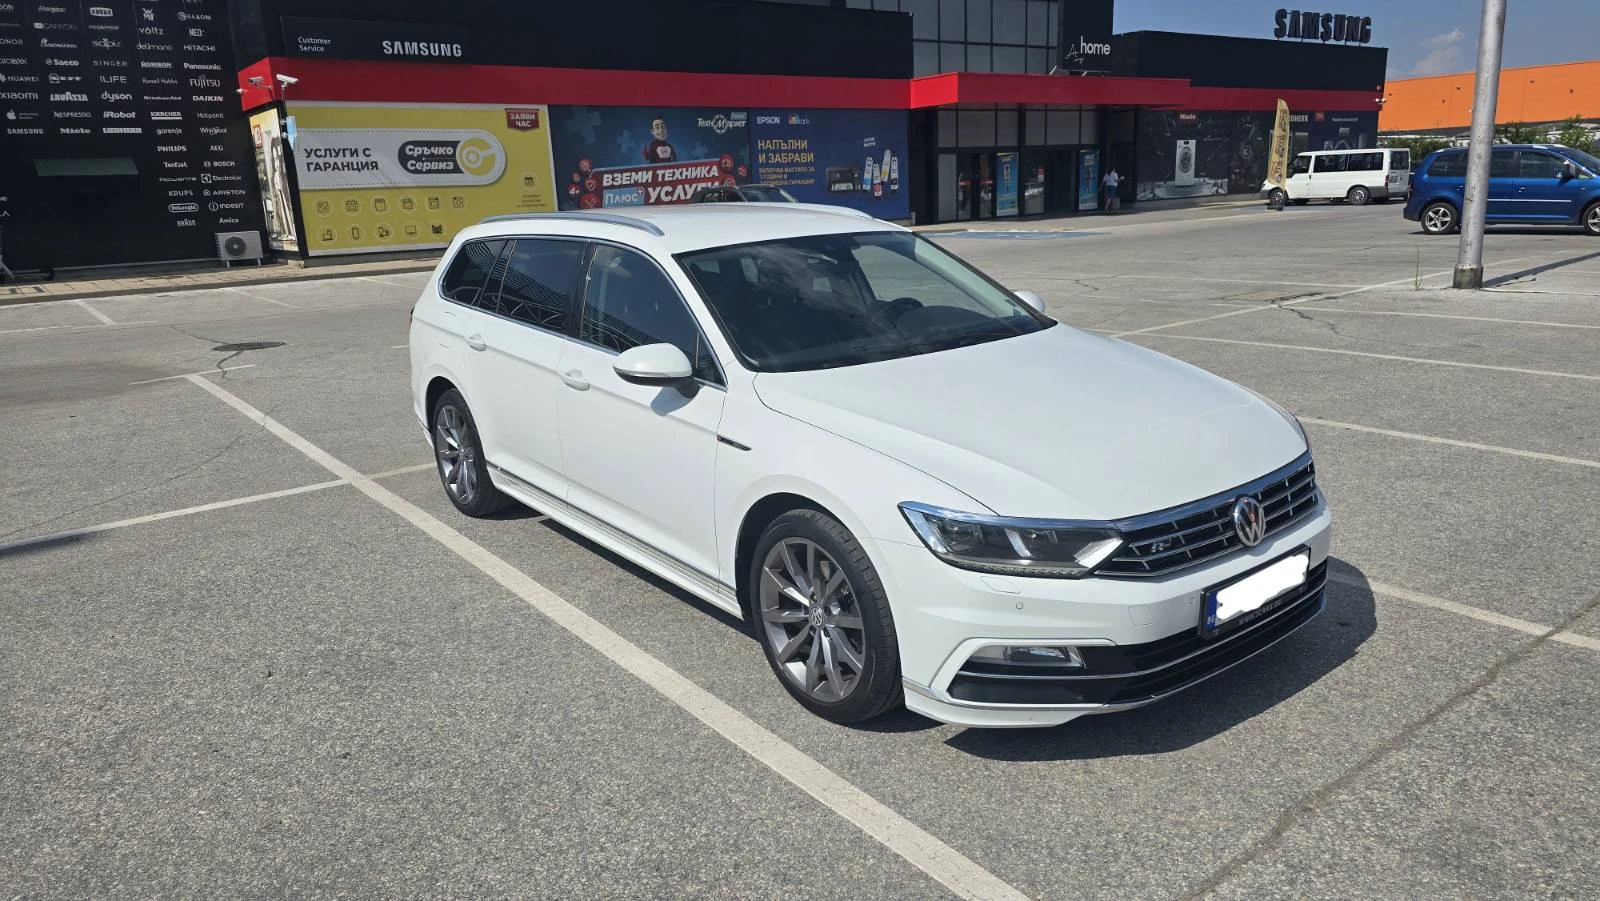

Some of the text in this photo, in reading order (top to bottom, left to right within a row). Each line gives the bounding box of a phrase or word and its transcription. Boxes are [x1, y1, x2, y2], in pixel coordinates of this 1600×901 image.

[1274, 8, 1372, 43] SAMSUNG
[297, 36, 331, 45] Customer
[1080, 35, 1111, 55] home
[300, 44, 325, 53] Service
[382, 40, 462, 57] SAMSUNG
[183, 62, 222, 70] Panasonic
[100, 91, 133, 102] dyson
[103, 110, 136, 118] iRobot
[509, 113, 536, 122] ЗАЯВИ
[515, 120, 532, 128] ЧАС
[757, 116, 781, 125] EPSON
[405, 144, 454, 156] Сръчко
[758, 139, 808, 150] НАПЪЛНИ
[305, 147, 372, 160] УСЛУГИ С
[758, 152, 815, 164] И ЗАБРАВИ
[306, 160, 379, 173] ГАРАНЦИЯ
[406, 159, 455, 172] Сервиз
[602, 165, 719, 187] ВЗЕМИ ТЕХНИКА
